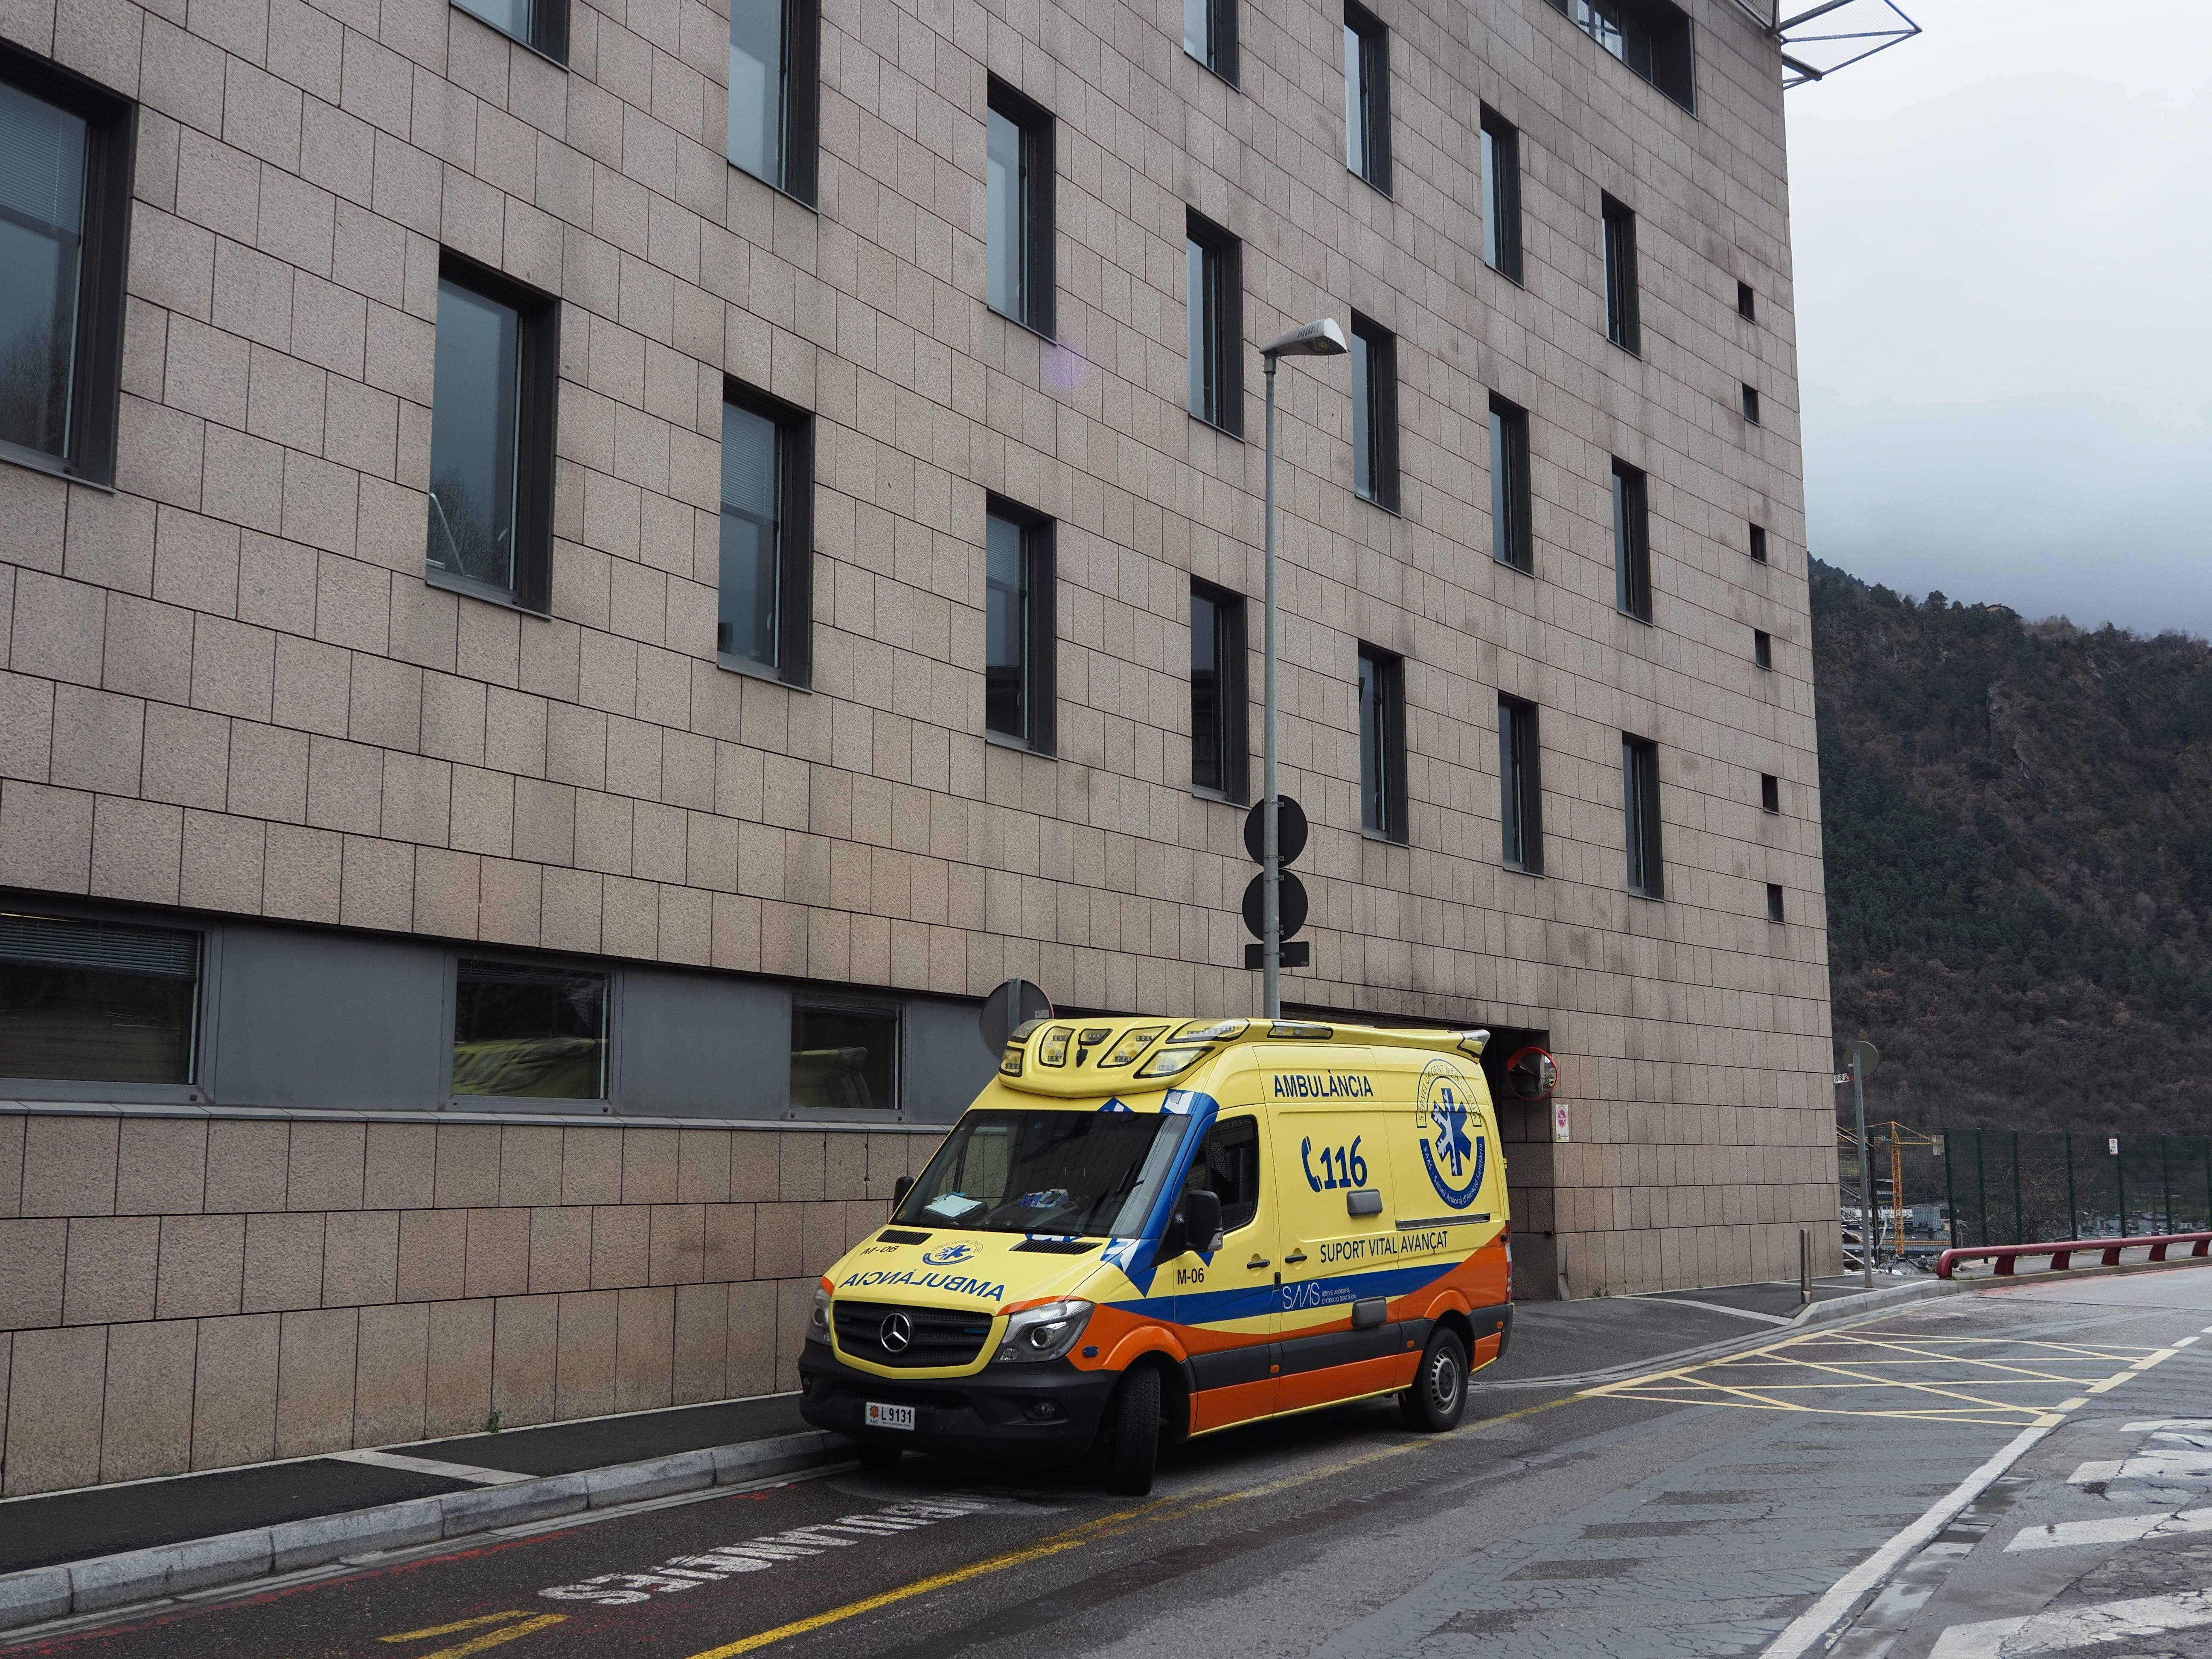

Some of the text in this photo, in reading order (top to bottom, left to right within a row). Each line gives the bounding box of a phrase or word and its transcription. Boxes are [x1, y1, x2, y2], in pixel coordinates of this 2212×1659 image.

[1274, 1068, 1374, 1097] AMBULÀNCIA
[1424, 1064, 1444, 1085] URGENT
[1320, 1135, 1368, 1189] 116
[1423, 1146, 1433, 1170] SAAS
[1433, 1175, 1446, 1197] Servei
[859, 1246, 899, 1256] M-06
[1320, 1231, 1448, 1263] SUPORT VITAL AVANÇAT
[1177, 1267, 1204, 1285] M-06
[882, 1407, 911, 1423] L 9131
[537, 1492, 1015, 1605] MBULANCIES
